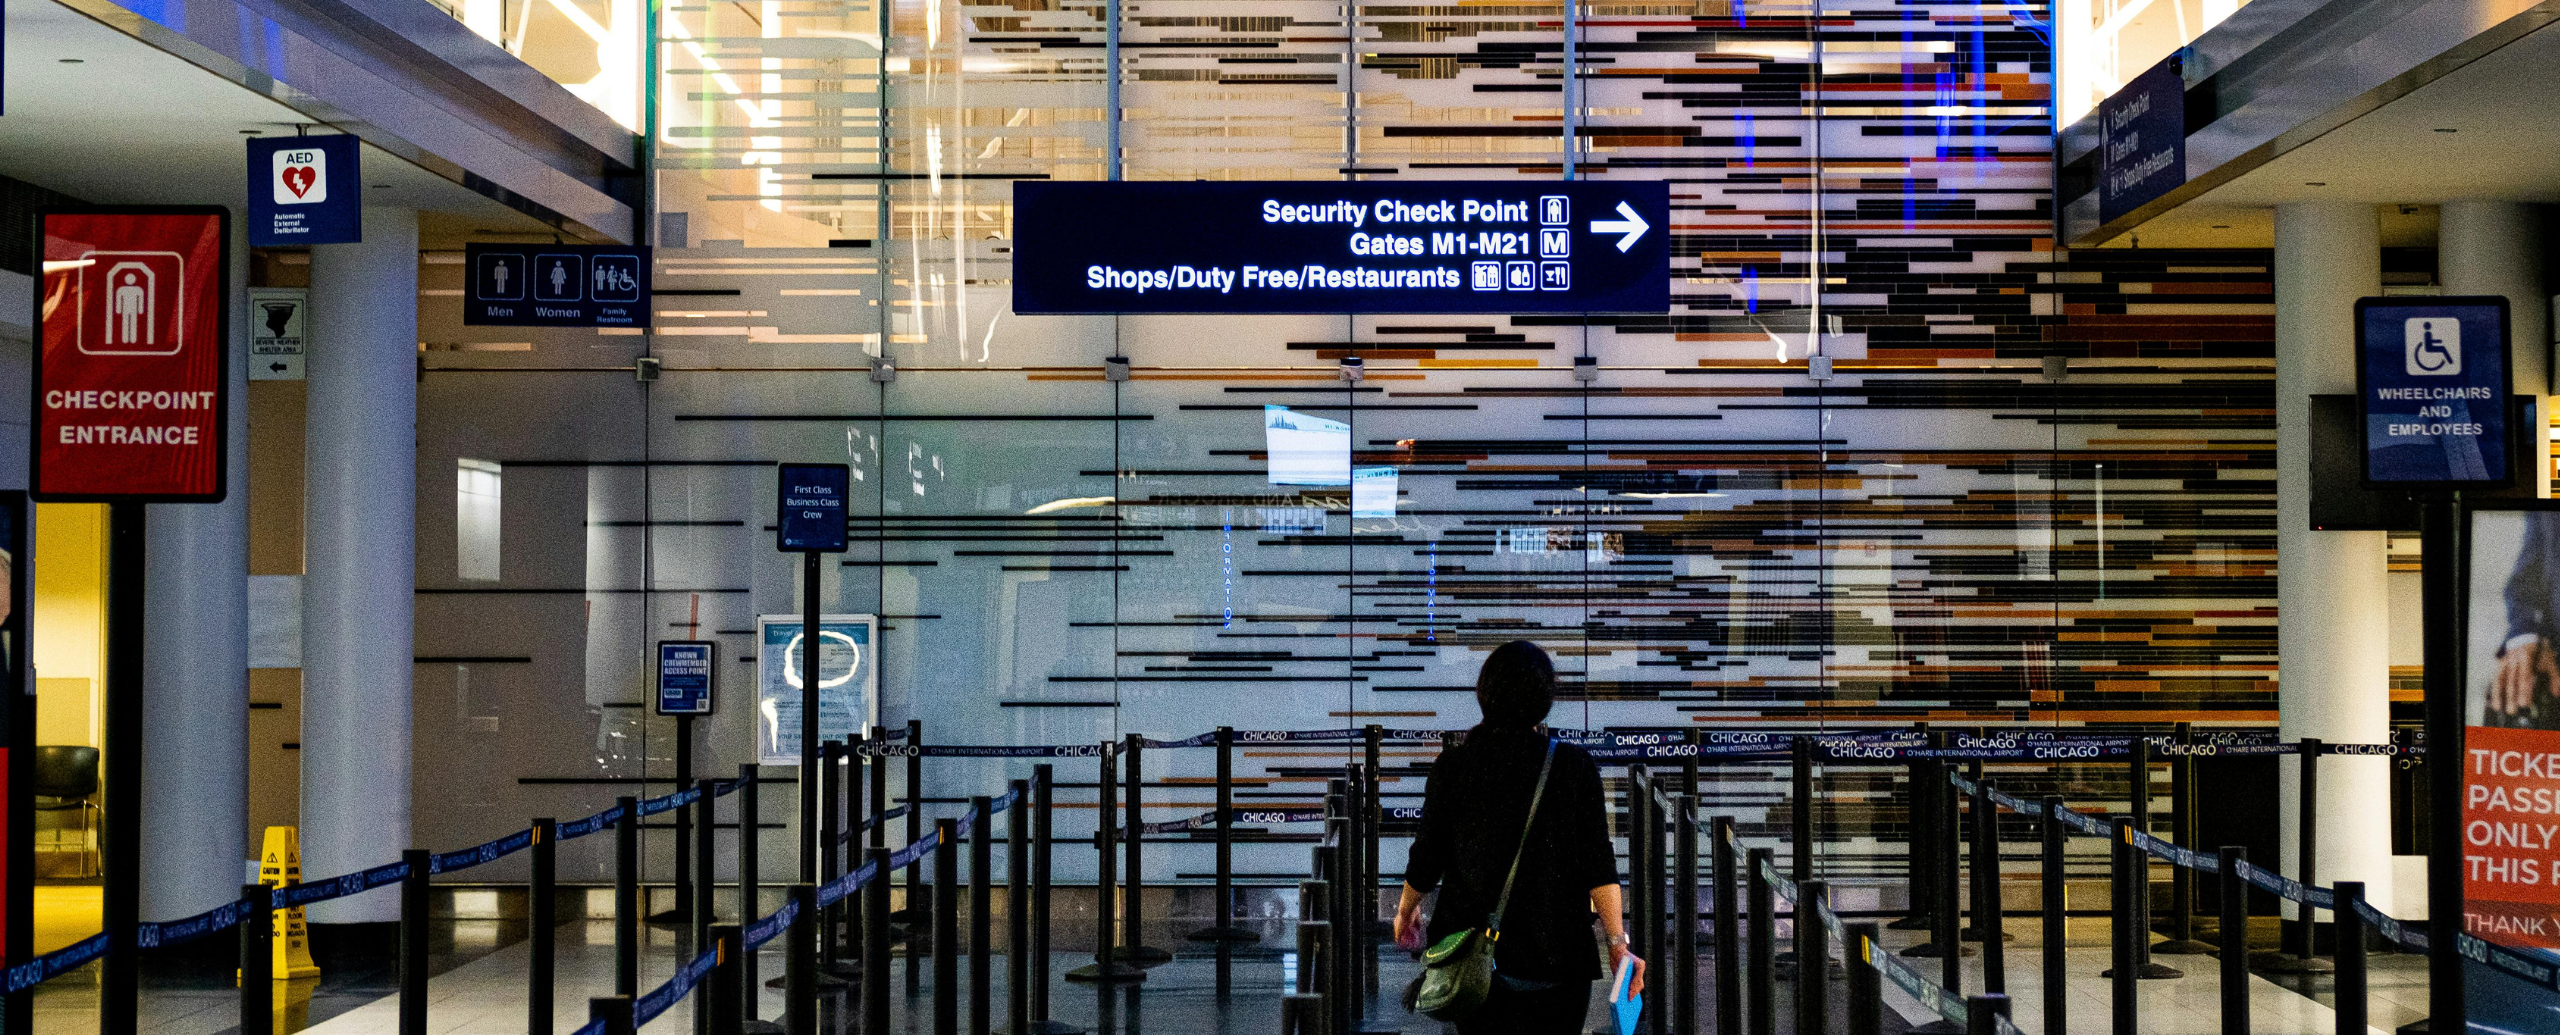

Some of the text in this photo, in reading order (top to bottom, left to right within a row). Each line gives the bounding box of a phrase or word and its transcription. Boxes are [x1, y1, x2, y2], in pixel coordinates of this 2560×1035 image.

[286, 152, 314, 164] AED
[274, 213, 305, 221] Automatic
[1263, 199, 1529, 228] Security Check Point
[274, 220, 300, 228] External
[274, 227, 310, 235] Defibrillator
[1350, 233, 1567, 256] Gates M1-M21 M
[1087, 265, 1461, 294] Shops/Duty Free/Restaurants
[487, 306, 514, 317] Men
[535, 307, 581, 318] Women
[602, 308, 627, 316] Family
[596, 315, 633, 324] Restroom
[2377, 387, 2491, 400] WHEELCHAIRS
[46, 390, 214, 410] CHECKPOINT
[2418, 405, 2452, 418] AND
[59, 425, 199, 445] ENTRANCE
[2388, 423, 2483, 436] EMPLOYEES
[794, 486, 832, 494] First Class
[786, 498, 840, 507] Business Class
[803, 511, 823, 519] Crew
[664, 659, 707, 667] CREWMEMBER
[664, 667, 706, 675] ACCESS POINT
[1243, 731, 1288, 741] CHICAGO
[1583, 737, 1605, 745] AIRPORT
[1615, 734, 1660, 746] CHICAGO
[1710, 732, 1768, 744] CHICAGO
[1891, 732, 1928, 741] CHICA
[1958, 737, 2016, 749] CHICAGO
[2053, 739, 2104, 747] INTERNATIONAL
[857, 744, 1045, 757] CHICAGO O'HARE INTERNATIONAL AIRPORT
[1615, 748, 1639, 756] AIRPORT
[1647, 744, 1698, 757] CHICAGO
[1728, 743, 1772, 752] INTERNATIONAL
[1830, 746, 2024, 758] CHICAGO O'HARE INTERNATIONAL AIRPORT
[2034, 745, 2130, 758] CHICAGO O'HA
[2161, 744, 2298, 756] CHICAGO O'HARE INTERNATIONAL
[2334, 744, 2398, 756] CHICAGO
[2469, 749, 2560, 779] TICKE
[1243, 812, 1286, 823] CHICAGO
[1292, 813, 1311, 821] O'HARE
[1393, 808, 1421, 818] CHIC
[2466, 820, 2558, 850] ONLY
[2465, 855, 2540, 885] THIS
[2464, 913, 2546, 936] THANK
